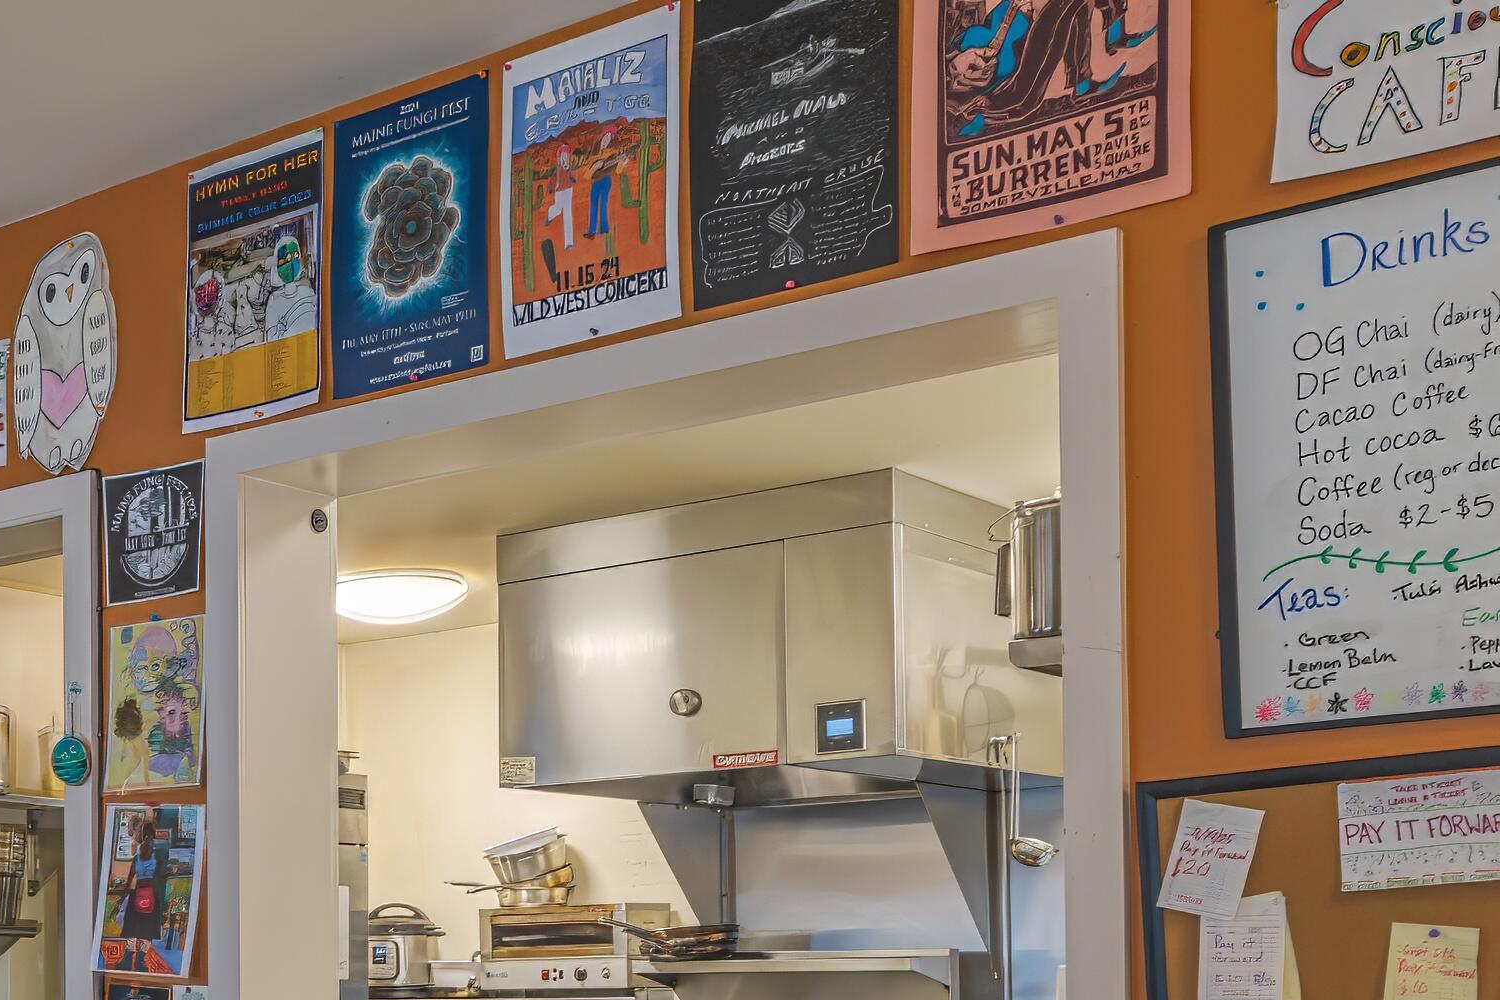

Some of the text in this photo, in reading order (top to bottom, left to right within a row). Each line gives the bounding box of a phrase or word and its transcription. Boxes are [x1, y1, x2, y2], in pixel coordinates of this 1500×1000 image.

[396, 108, 437, 133] FUNGI
[441, 97, 470, 118] FEST
[1309, 47, 1500, 153] CAF
[1027, 116, 1094, 161] MAY
[1094, 141, 1150, 170] SQUARE
[195, 150, 318, 202] HYMN FOR HER
[824, 149, 884, 183] CRUISE
[966, 147, 1092, 203] BURREN
[1094, 132, 1139, 156] DAVIS
[1322, 207, 1491, 287] Drinks
[1293, 326, 1345, 361] OG
[1356, 316, 1409, 348] Chai
[1297, 366, 1340, 401] DF
[1354, 359, 1407, 388] Chai
[1295, 382, 1469, 433] Cacao Coffee
[1298, 436, 1350, 467] Hot
[1365, 428, 1445, 456] cocoa
[132, 474, 165, 496] FUNGI
[1297, 474, 1384, 506] Coffee
[1441, 461, 1463, 476] or
[1297, 509, 1372, 545] Soda
[1257, 578, 1350, 621] Teas:
[1298, 631, 1370, 647] Green
[1345, 820, 1385, 845] PAY
[1396, 819, 1419, 841] IT
